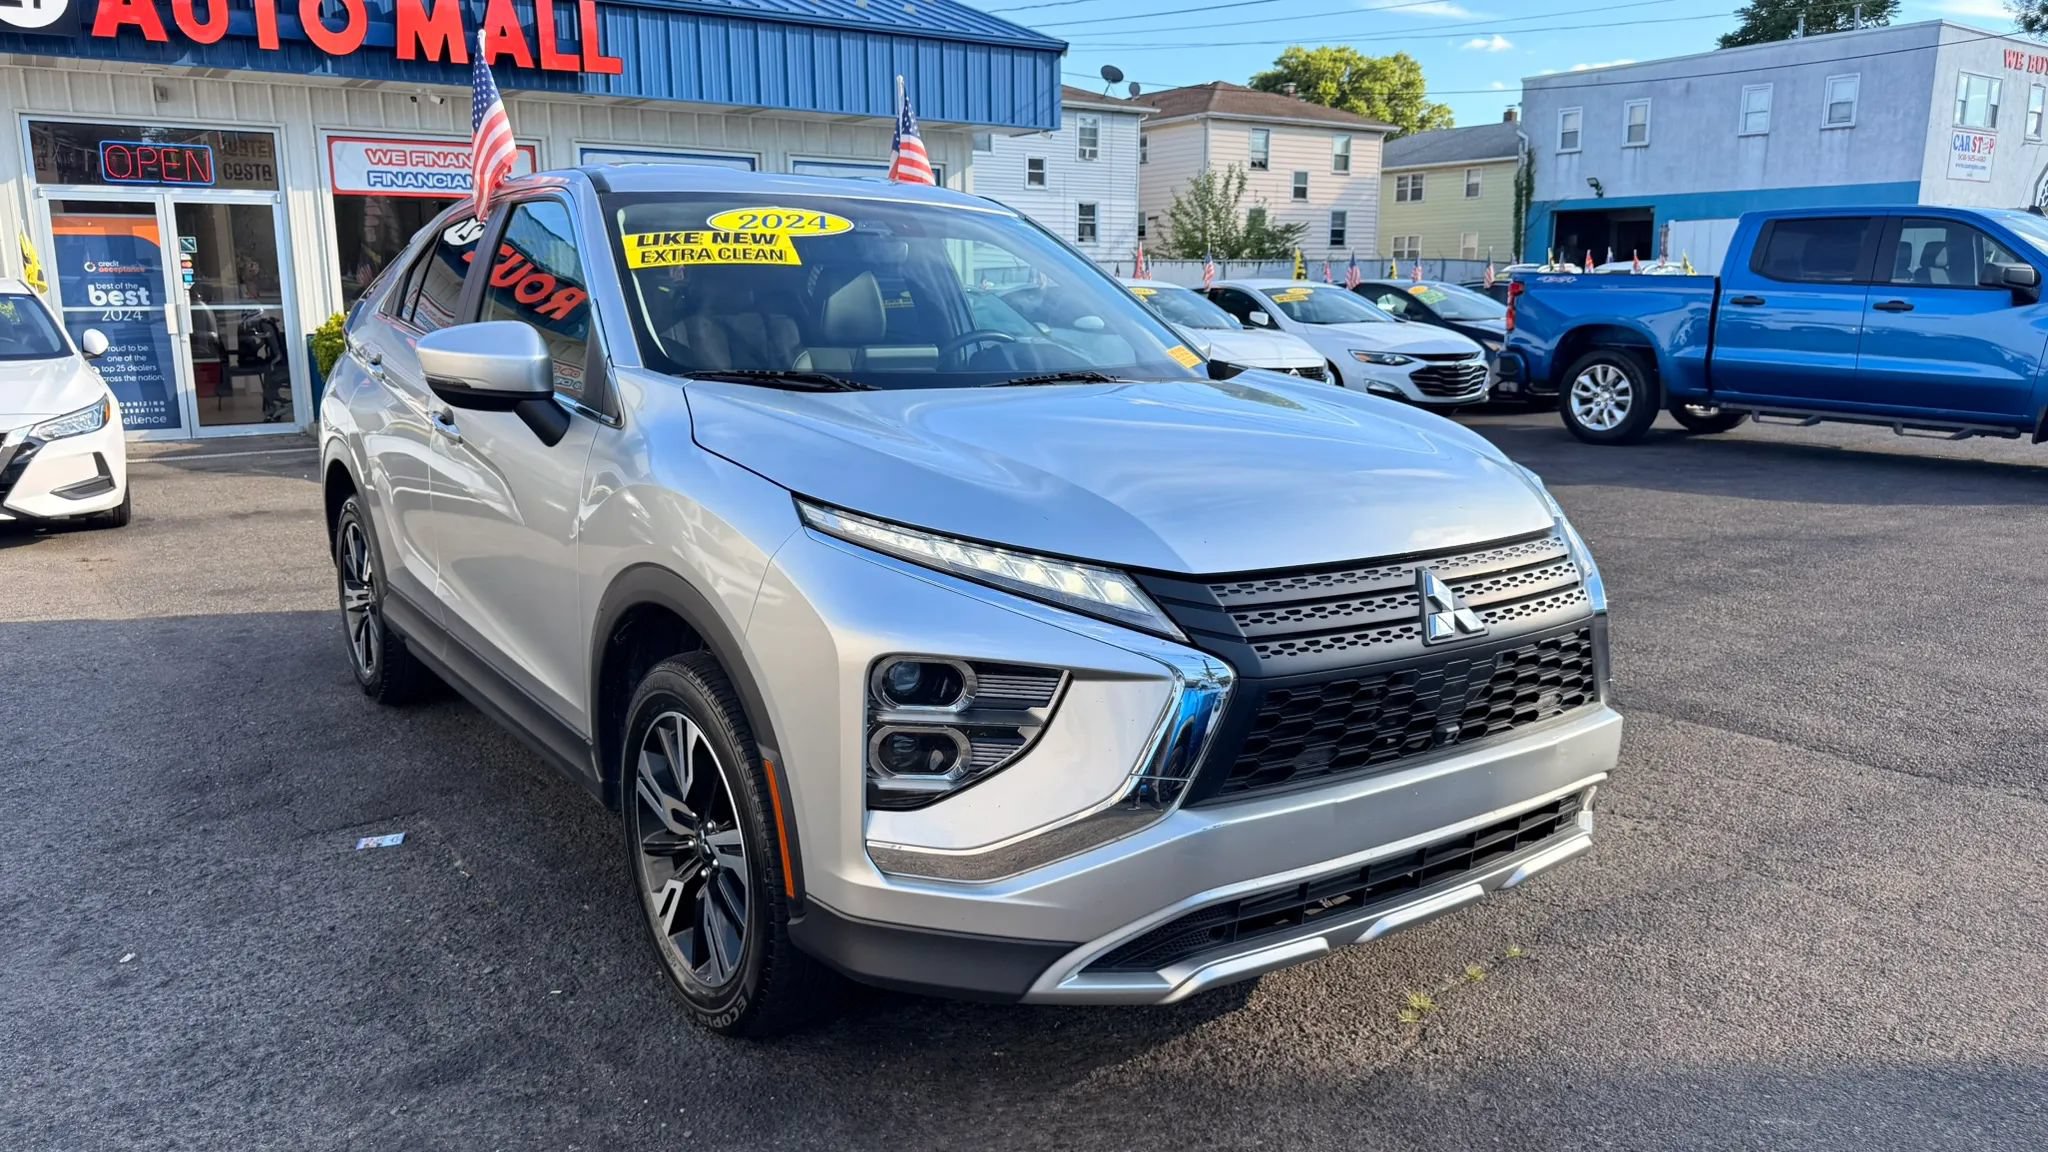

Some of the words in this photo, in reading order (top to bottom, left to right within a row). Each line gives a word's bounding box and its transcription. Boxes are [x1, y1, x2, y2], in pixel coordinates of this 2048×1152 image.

[396, 0, 623, 75] MALL
[2003, 49, 2023, 70] WE
[1953, 134, 1971, 152] CAR
[105, 144, 212, 182] OPEN
[365, 149, 406, 166] WE
[411, 150, 473, 169] FINAN
[223, 162, 272, 182] COSTA
[367, 171, 473, 189] FINANCIA
[738, 213, 830, 230] 2024
[636, 233, 698, 247] LIKE
[711, 232, 779, 246] NEW
[641, 248, 713, 263] EXTRA
[717, 248, 787, 263] CLEAN
[88, 284, 150, 306] best
[102, 309, 143, 321] 2024
[123, 415, 167, 424] ellence
